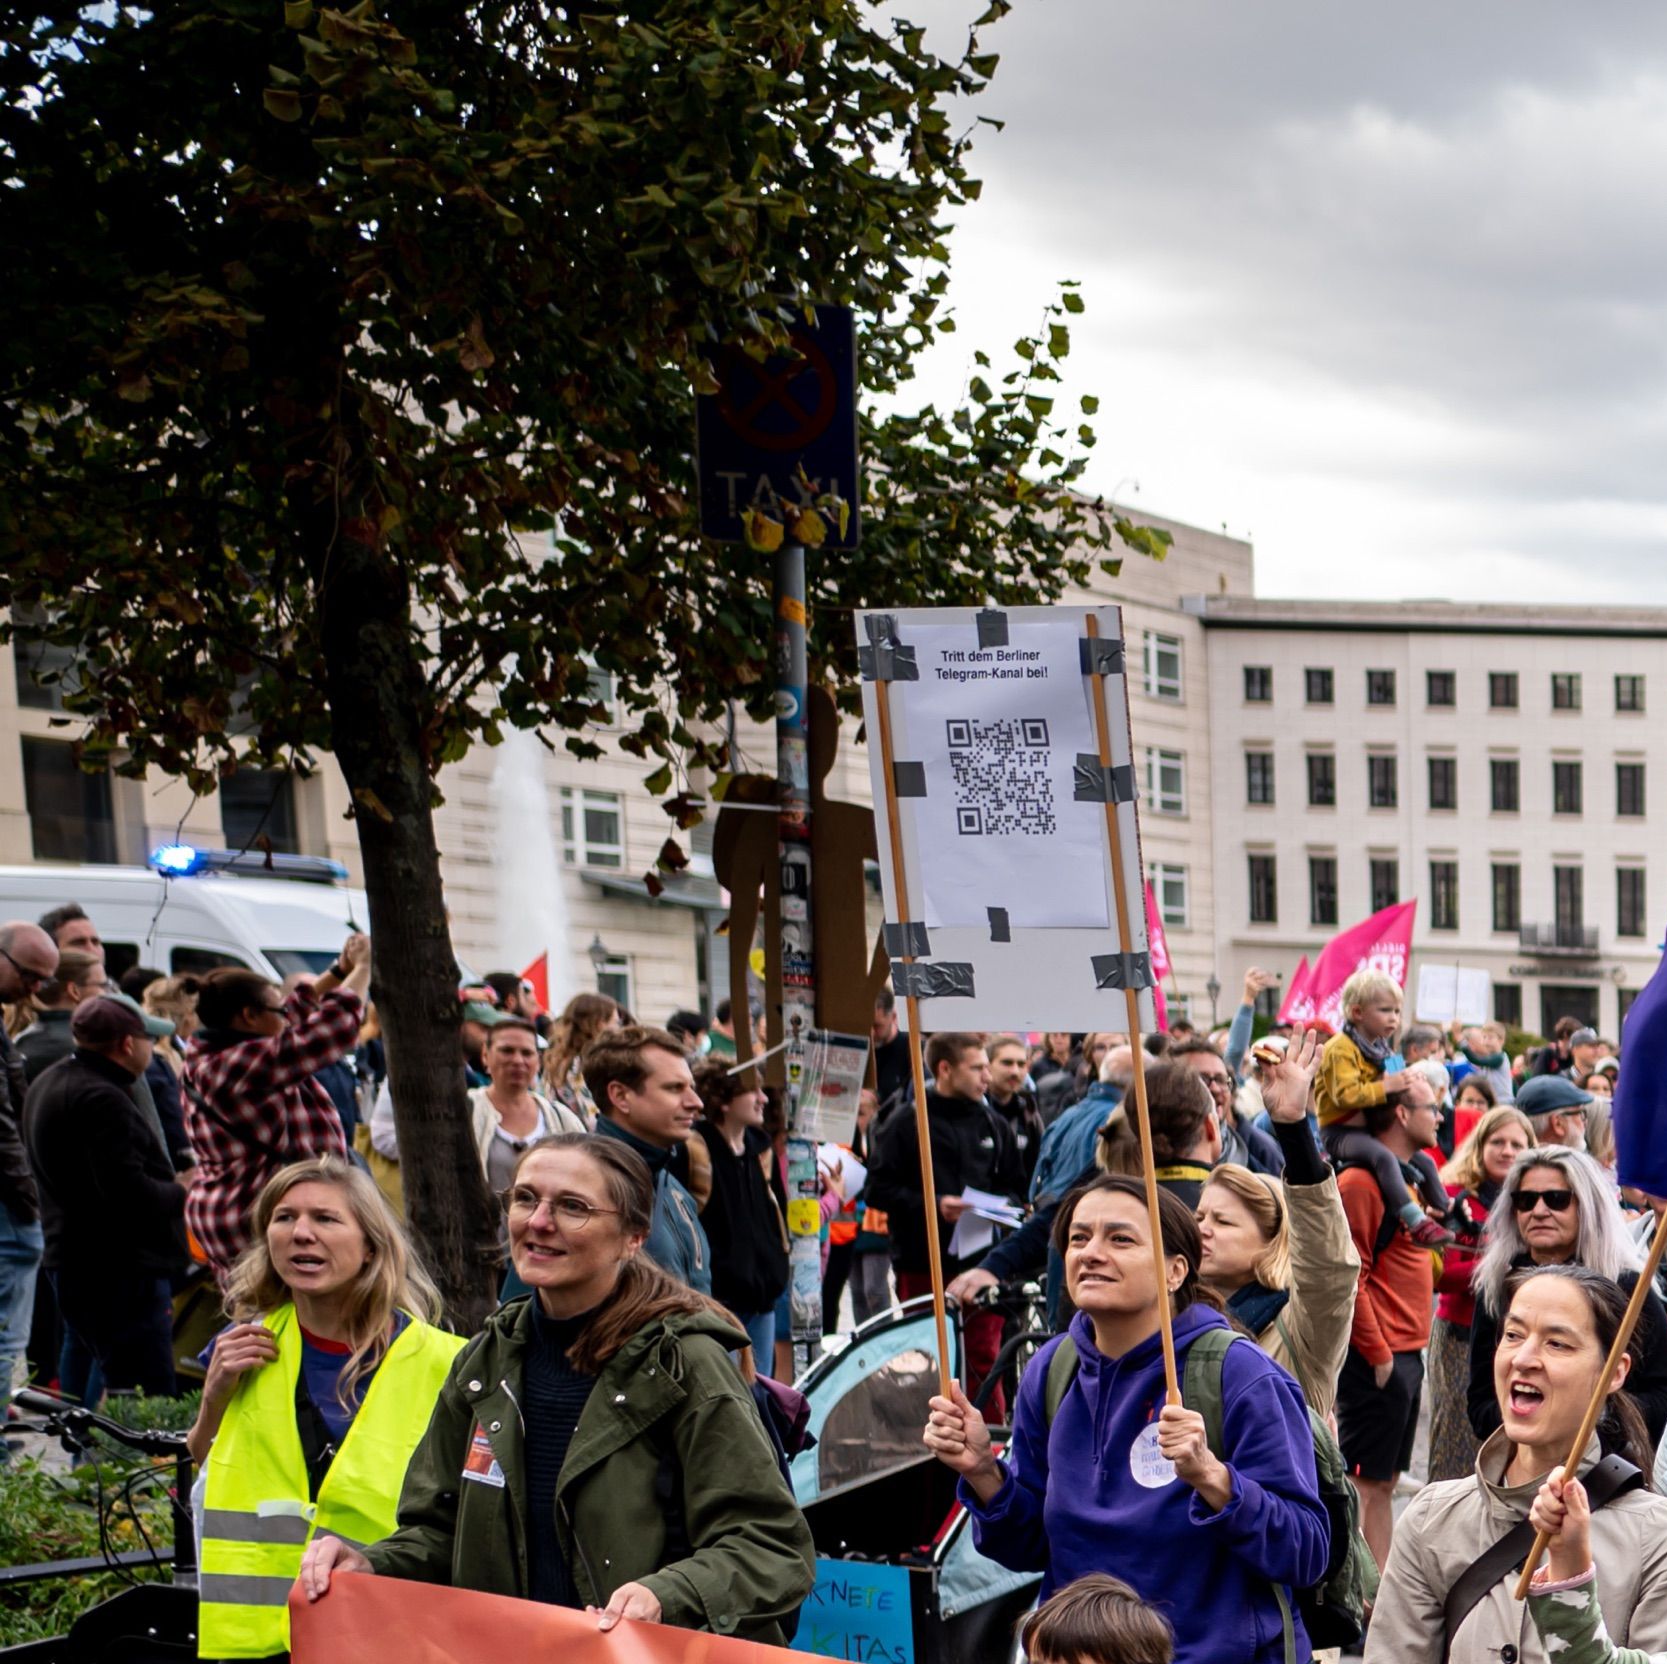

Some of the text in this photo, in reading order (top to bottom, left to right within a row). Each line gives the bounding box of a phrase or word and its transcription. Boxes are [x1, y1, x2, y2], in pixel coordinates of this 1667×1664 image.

[715, 471, 839, 522] TAXI
[941, 650, 1040, 662] Tritt dem Berliner
[935, 666, 1048, 682] Telegram-Kanal bei!
[808, 1580, 895, 1611] KNETE
